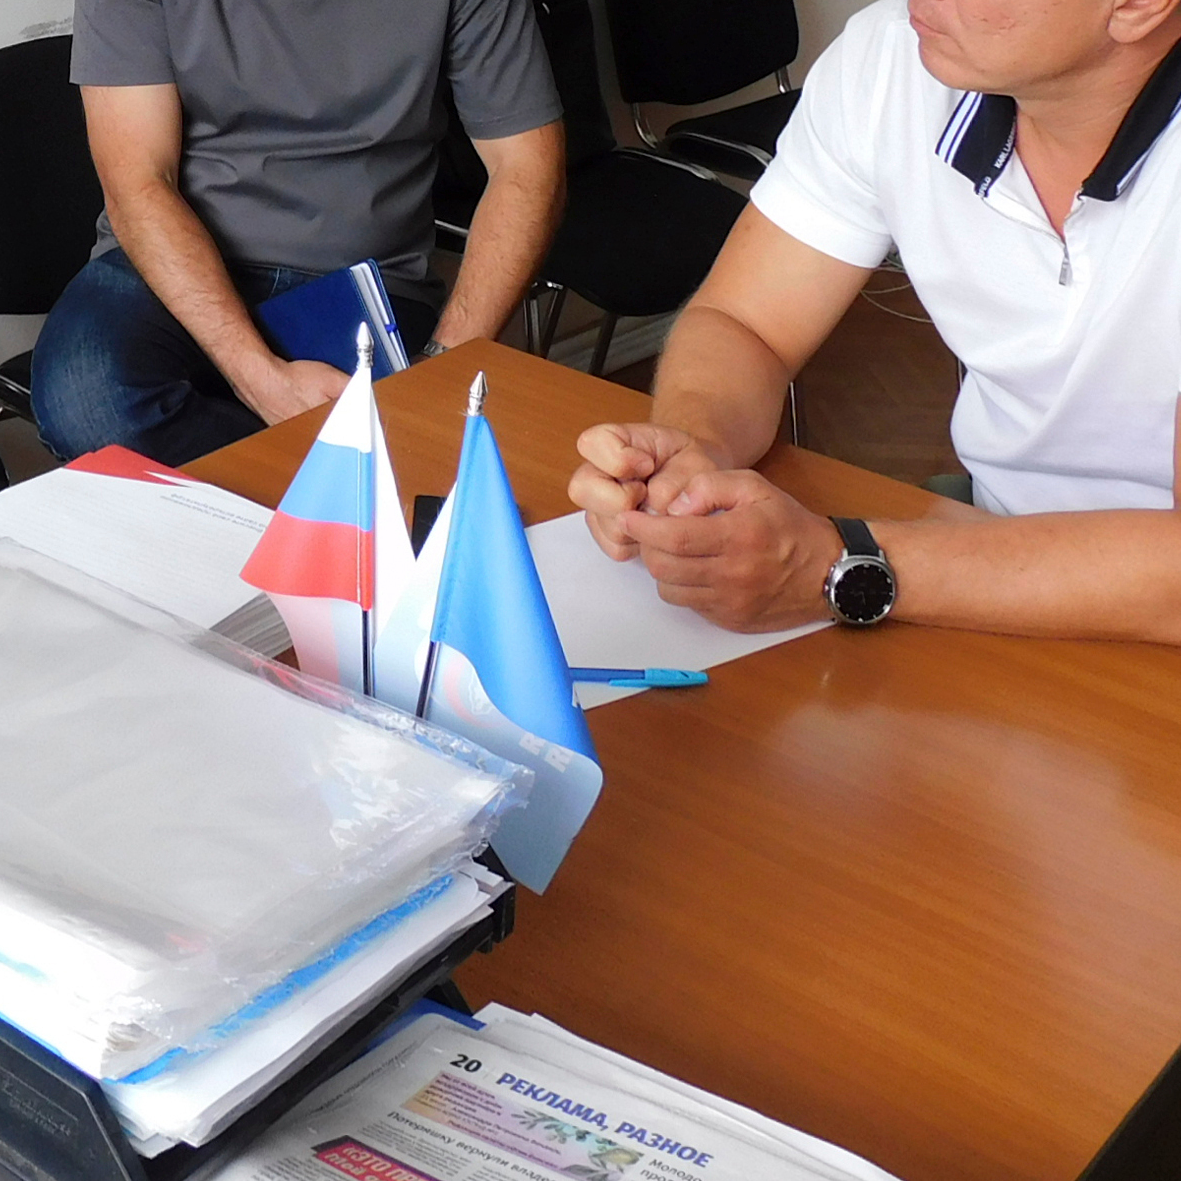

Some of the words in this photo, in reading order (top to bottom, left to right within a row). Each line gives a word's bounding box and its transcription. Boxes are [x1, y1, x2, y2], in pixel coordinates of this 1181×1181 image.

[450, 1053, 482, 1073] 20
[387, 1111, 455, 1145] Потеряшку
[456, 1140, 509, 1167] вернули
[496, 1072, 609, 1131] РЕКЛАМА,
[615, 1121, 714, 1168] РАЗНОЕ
